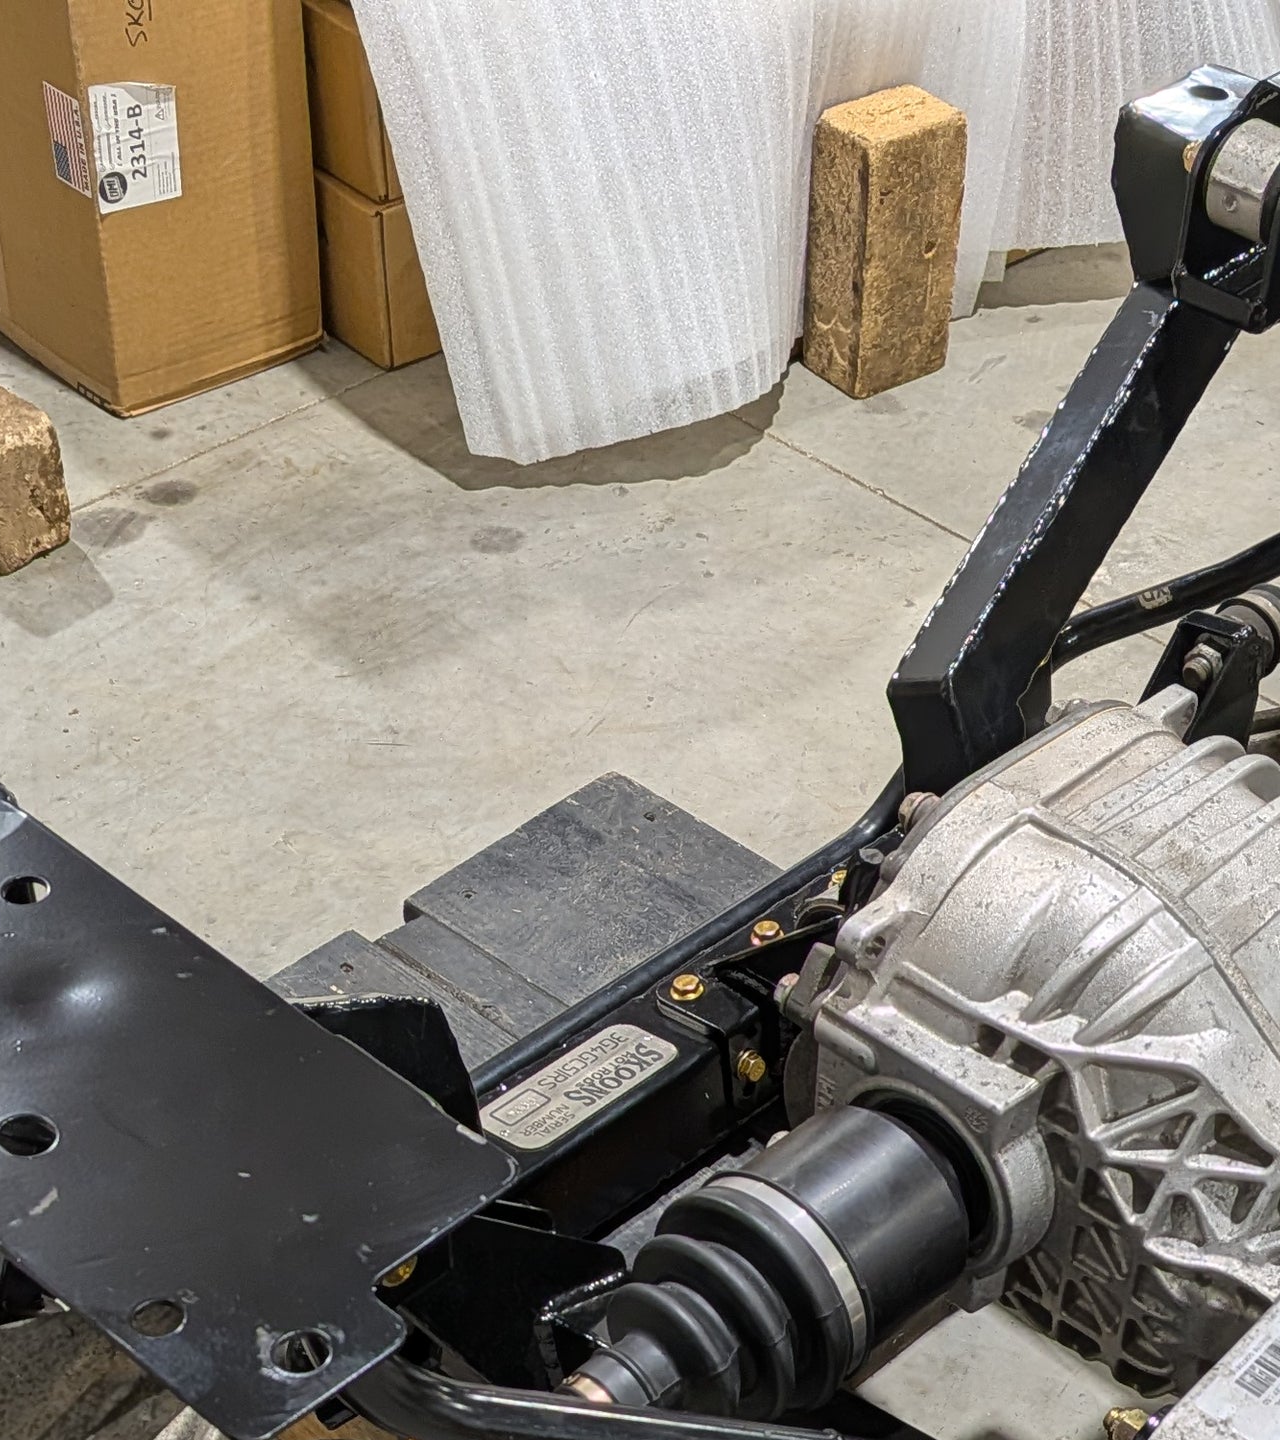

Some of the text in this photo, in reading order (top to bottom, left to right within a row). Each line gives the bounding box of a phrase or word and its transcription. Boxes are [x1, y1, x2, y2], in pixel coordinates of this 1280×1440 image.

[78, 142, 85, 155] IN
[127, 104, 148, 180] 2314-B
[80, 164, 90, 192] MADE
[563, 1043, 665, 1108] SKOONS
[519, 1103, 569, 1137] NUMBER
[532, 1111, 576, 1139] SERIAL
